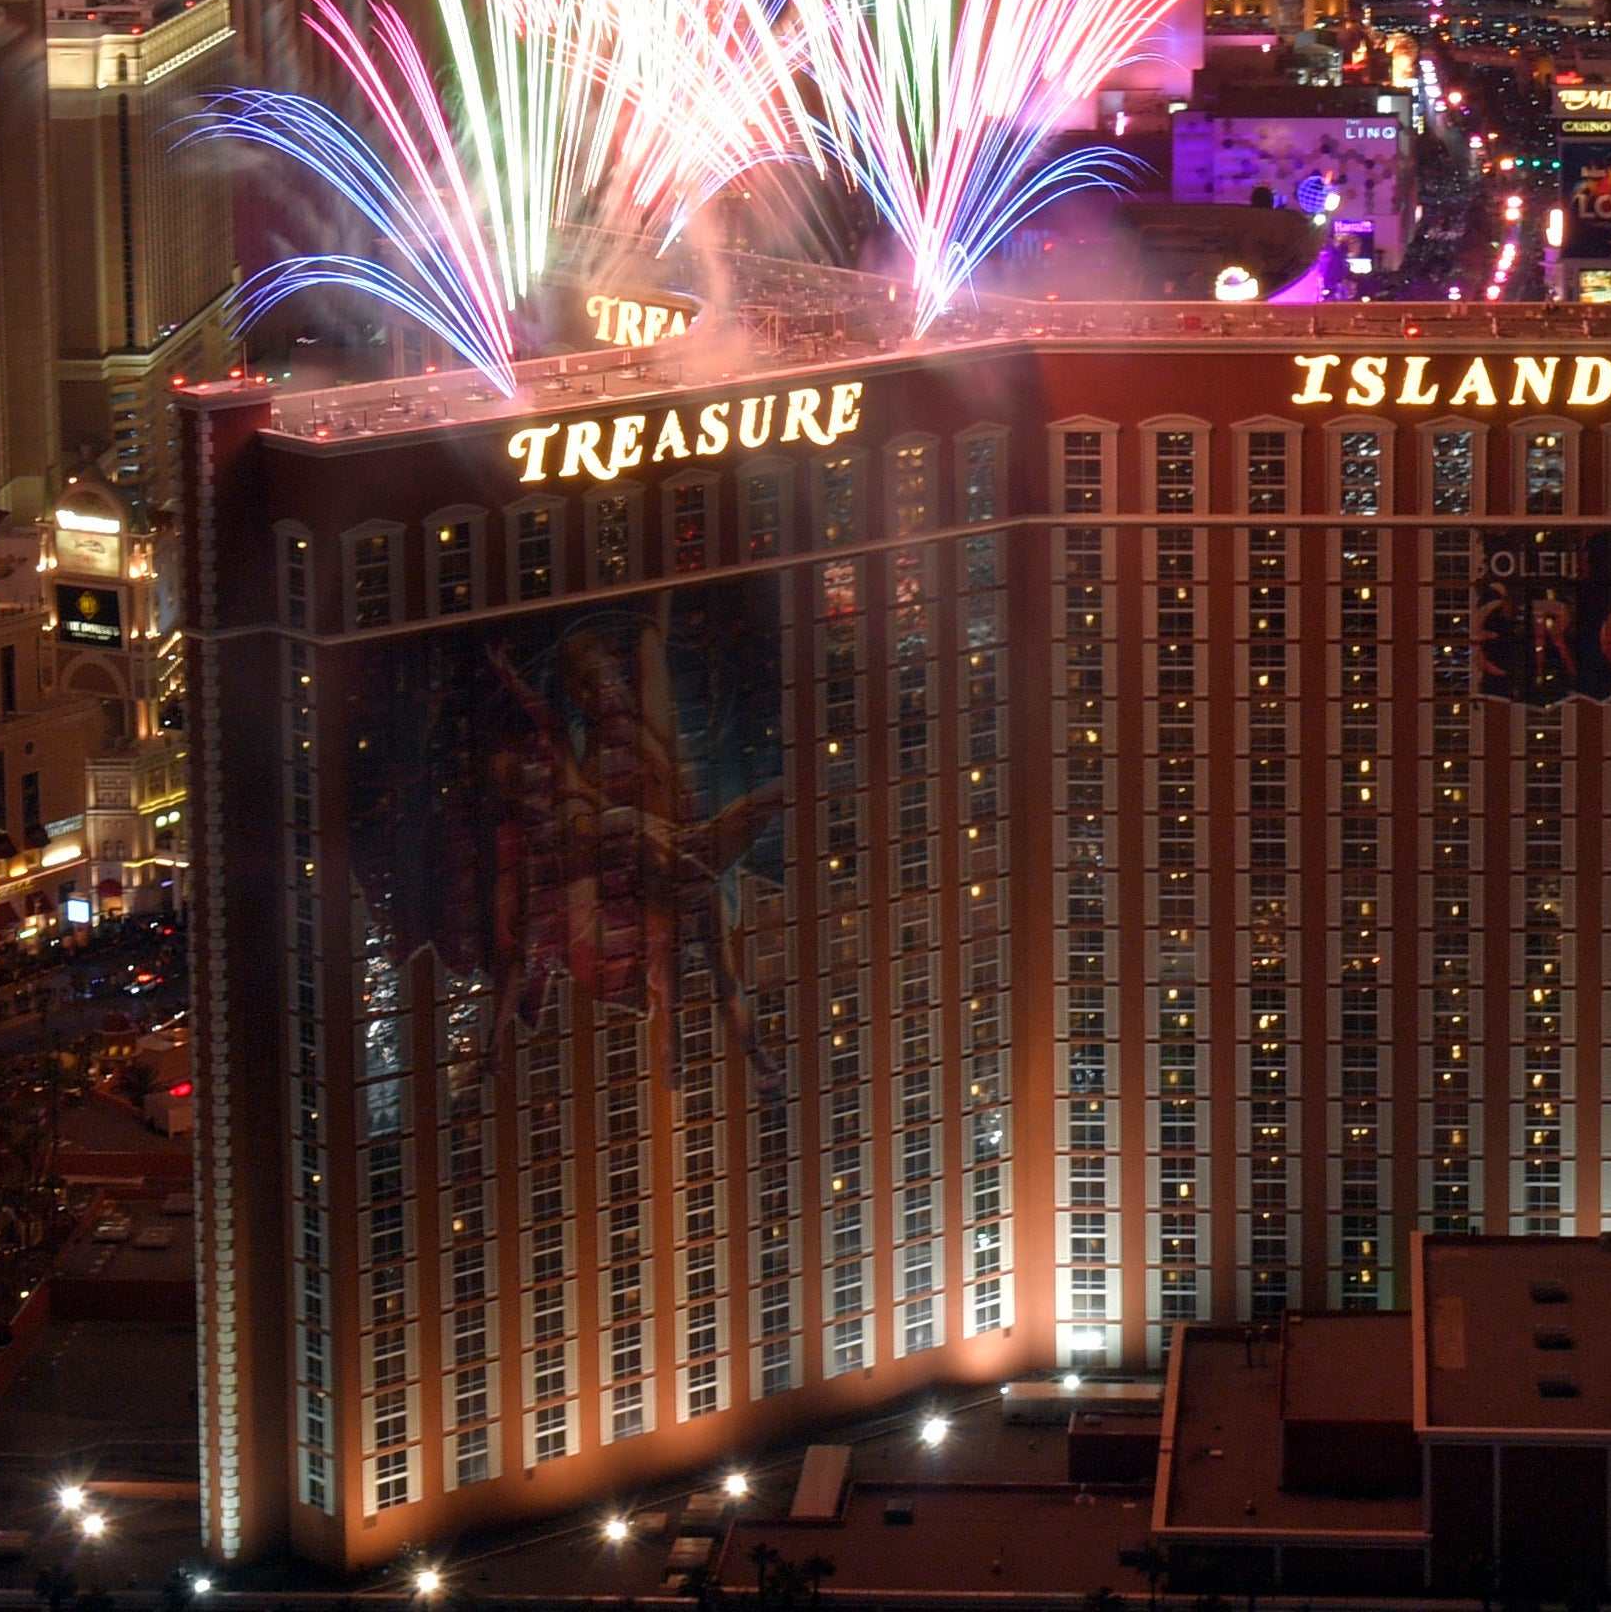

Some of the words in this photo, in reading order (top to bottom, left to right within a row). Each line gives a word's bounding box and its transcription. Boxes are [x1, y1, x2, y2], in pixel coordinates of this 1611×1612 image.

[1558, 89, 1587, 103] THE
[1561, 121, 1611, 133] CASINO
[585, 295, 699, 348] TREA
[507, 382, 864, 484] TREASURE
